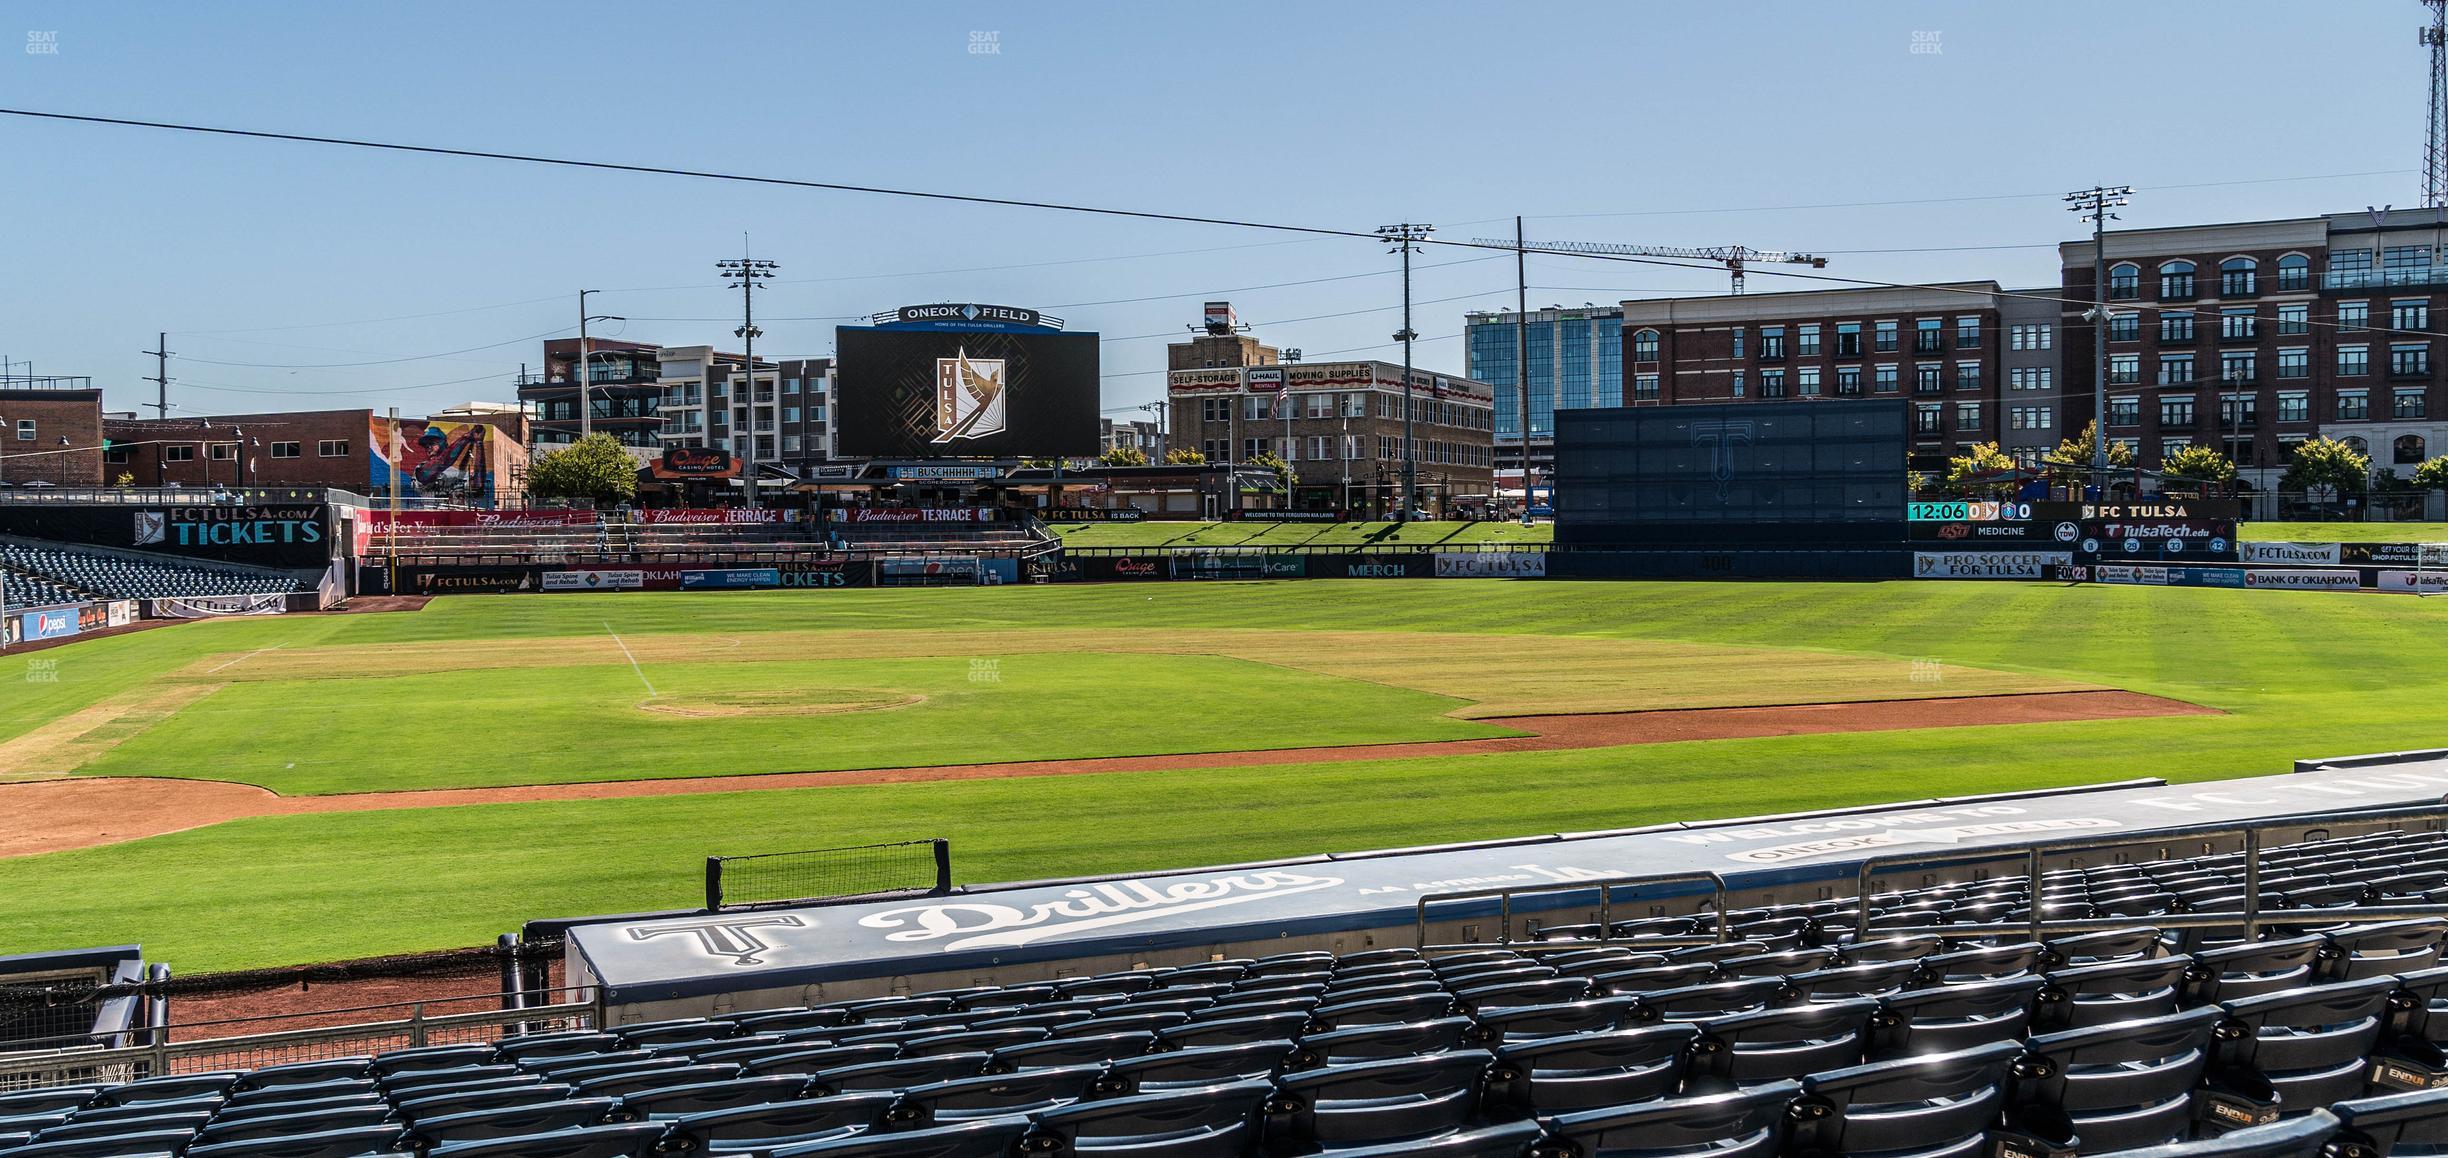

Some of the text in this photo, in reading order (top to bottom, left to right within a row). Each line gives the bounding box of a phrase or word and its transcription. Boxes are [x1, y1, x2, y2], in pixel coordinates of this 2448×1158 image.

[907, 306, 1030, 321] ONEOK FIELD
[1173, 374, 1236, 385] SELF-STORAGE
[1289, 368, 1371, 380] MOVING SUPPLIES
[942, 364, 953, 425] TULSA
[651, 510, 719, 523] Budweiser
[855, 509, 972, 522] Budweiser TERRACE
[1053, 511, 1067, 520] FC
[1071, 510, 1105, 520] TULSA
[1912, 505, 1965, 519] 12:06
[1969, 504, 1980, 518] 0
[2019, 504, 2031, 518] 0
[2099, 505, 2188, 517] FC TULSA
[171, 520, 321, 546] TICKETS
[1978, 527, 2025, 535] MEDICINE
[2123, 524, 2210, 538] TulsaTech.edu
[2126, 542, 2138, 550] 29
[2169, 542, 2181, 550] 33
[2211, 542, 2224, 550] 42
[2258, 547, 2331, 560] FCTULSA.COM
[1456, 560, 1544, 572] FC TULSA
[1943, 555, 2042, 565] PRO SOCCER
[1115, 558, 1155, 576] Osage
[1348, 564, 1405, 577] MERCH
[1949, 565, 2036, 575] FOR TULSA
[562, 573, 579, 581] Spine
[642, 570, 682, 581] OKLAH
[2258, 576, 2359, 585] BANK OF OKLAHOMA
[48, 615, 66, 633] pepsi
[1663, 804, 2029, 846] WELCOME TO
[1748, 817, 2100, 861] ONEOK FIELD
[857, 868, 1345, 952] Drillers
